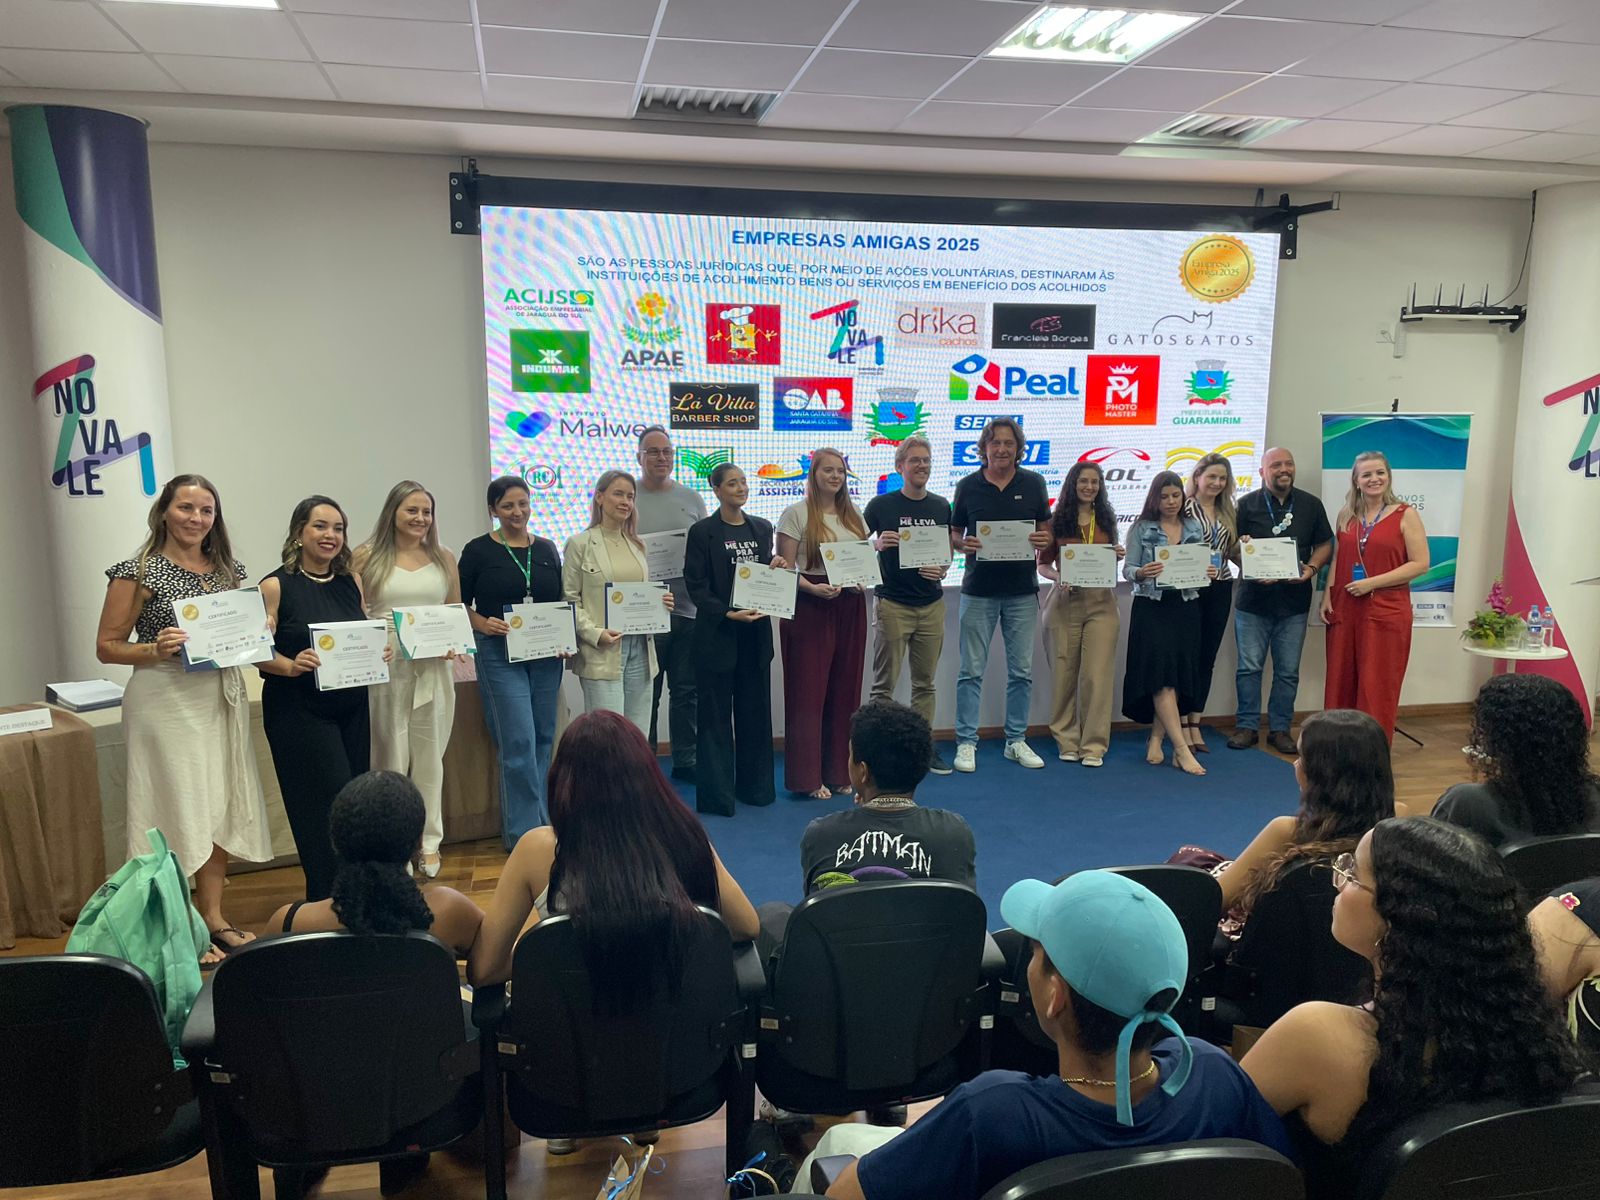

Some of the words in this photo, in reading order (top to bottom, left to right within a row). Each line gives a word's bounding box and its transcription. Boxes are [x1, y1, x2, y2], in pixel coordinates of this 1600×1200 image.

[731, 230, 846, 248] EMPRESAS
[852, 235, 931, 250] AMIGAS
[937, 237, 980, 251] 2025
[577, 255, 605, 267] SÃO
[609, 258, 627, 267] AS
[630, 258, 693, 270] PESSOAS
[697, 259, 763, 272] JURÍDICAS
[801, 264, 828, 274] POR
[831, 266, 863, 275] MEIO
[866, 266, 883, 276] DE
[886, 265, 929, 278] AÇÕES
[932, 266, 1018, 280] VOLUNTÁRIAS,
[1021, 269, 1097, 281] DESTINARAM
[1099, 269, 1115, 281] ÀS
[587, 270, 679, 283] INSTITUIÇÕES
[682, 274, 700, 283] DE
[703, 275, 796, 286] ACOLHIMENTO
[799, 278, 833, 287] BENS
[836, 278, 854, 288] OU
[858, 279, 920, 290] SERVIÇOS
[923, 280, 941, 289] EM
[944, 279, 1008, 291] BENEFÍCIO
[1011, 282, 1037, 291] DOS
[1039, 282, 1107, 292] ACOLHIDOS
[504, 288, 567, 304] ACIJS
[898, 307, 977, 335] drika
[939, 337, 977, 346] cachos
[621, 350, 684, 367] APAE
[521, 364, 580, 375] INDUMAK
[1004, 366, 1080, 395] Peal
[670, 392, 703, 411] La
[707, 393, 757, 411] Villa
[783, 388, 846, 411] OAB
[1105, 403, 1137, 411] PHOTO
[672, 414, 720, 423] BARBER
[723, 414, 756, 423] SHOP
[1172, 416, 1242, 425] GUARAMIRIM
[914, 518, 936, 526] LEVA
[724, 542, 738, 550] ME
[735, 548, 754, 557] PRA
[834, 830, 932, 878] BATMAN
